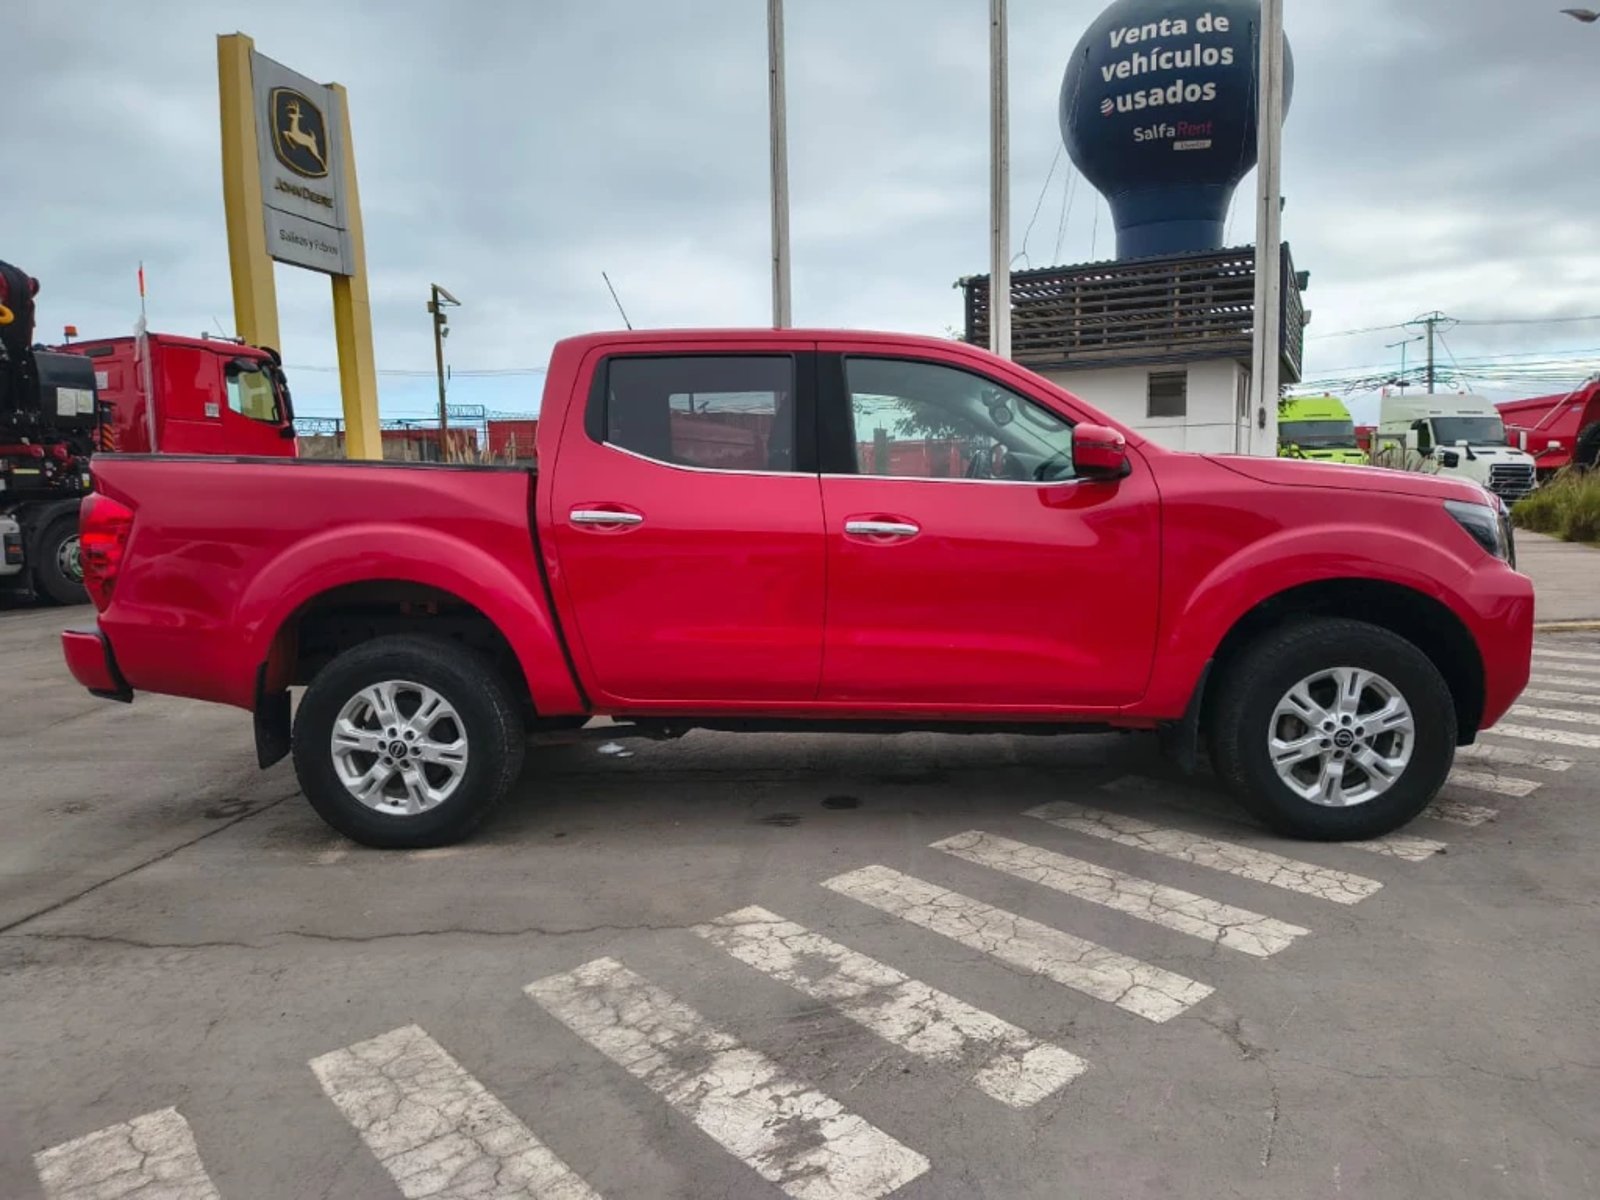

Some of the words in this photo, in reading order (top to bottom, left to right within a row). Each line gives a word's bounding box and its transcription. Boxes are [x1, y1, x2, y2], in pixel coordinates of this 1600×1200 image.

[1109, 18, 1187, 48] Venta
[1196, 12, 1229, 32] de
[1101, 43, 1234, 82] vehículos
[1116, 79, 1216, 113] usados
